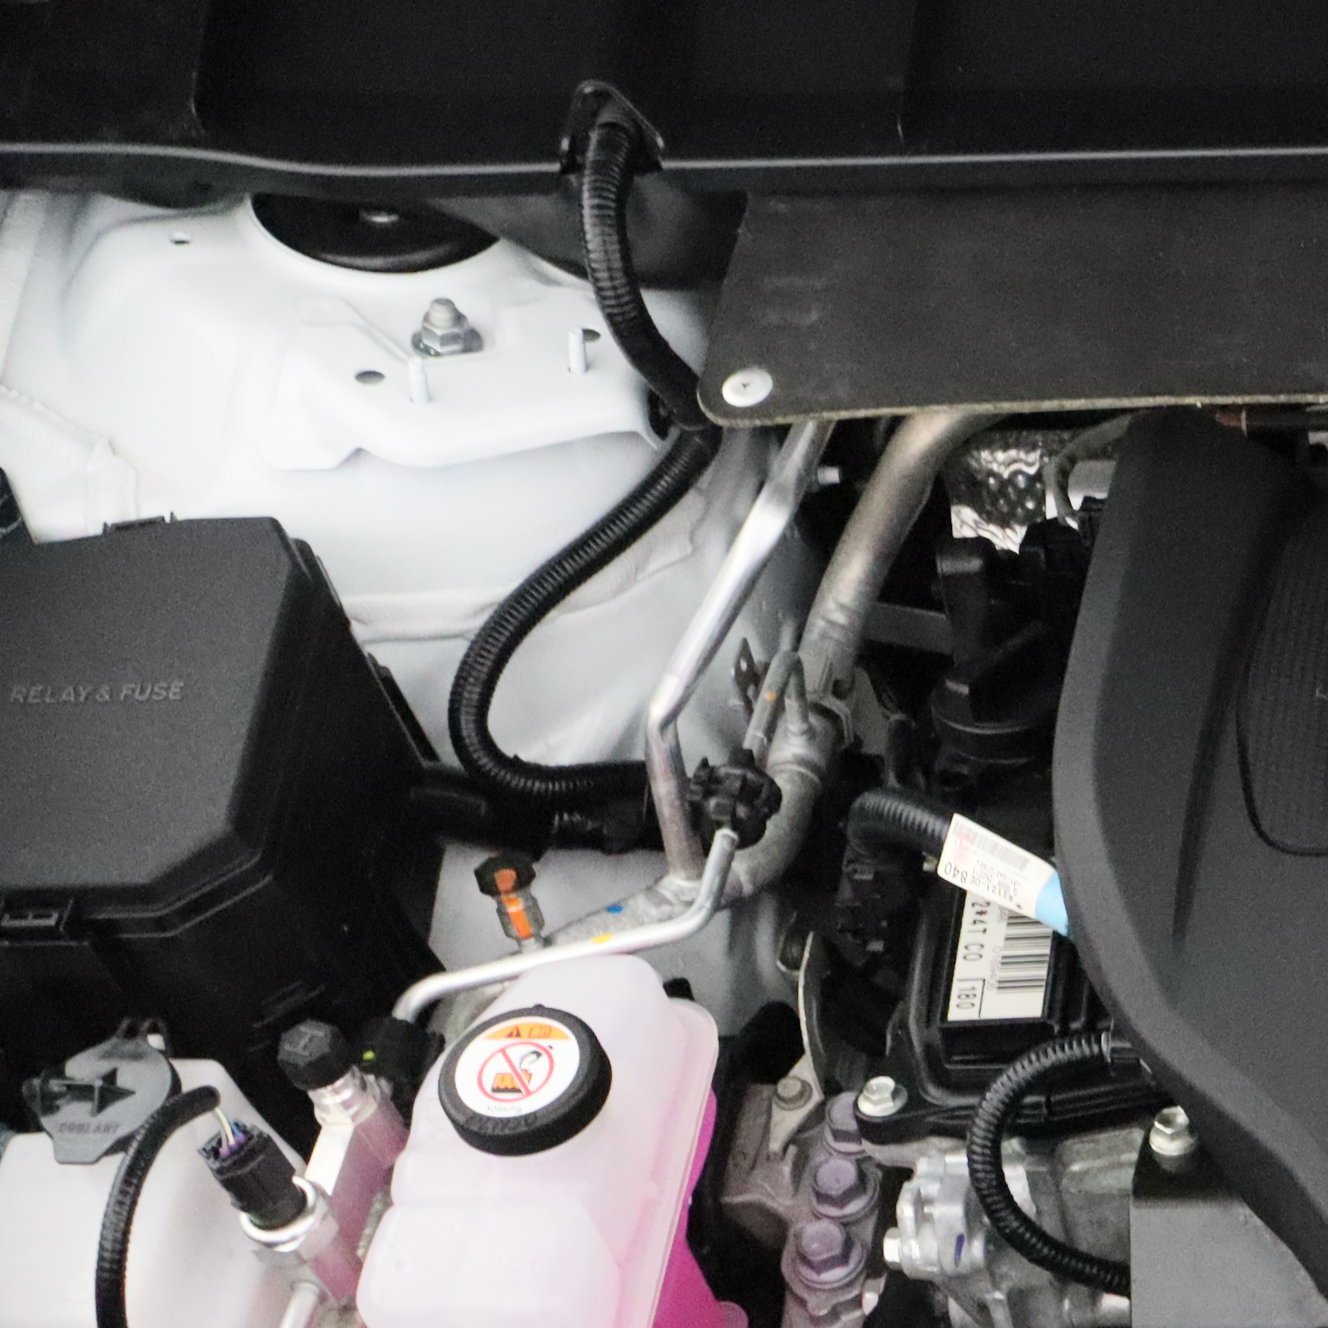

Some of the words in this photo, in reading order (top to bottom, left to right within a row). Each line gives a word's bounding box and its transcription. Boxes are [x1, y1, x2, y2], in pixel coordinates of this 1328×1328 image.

[10, 683, 93, 703] RELAY
[120, 680, 185, 701] FUSE
[956, 986, 977, 1010] 180
